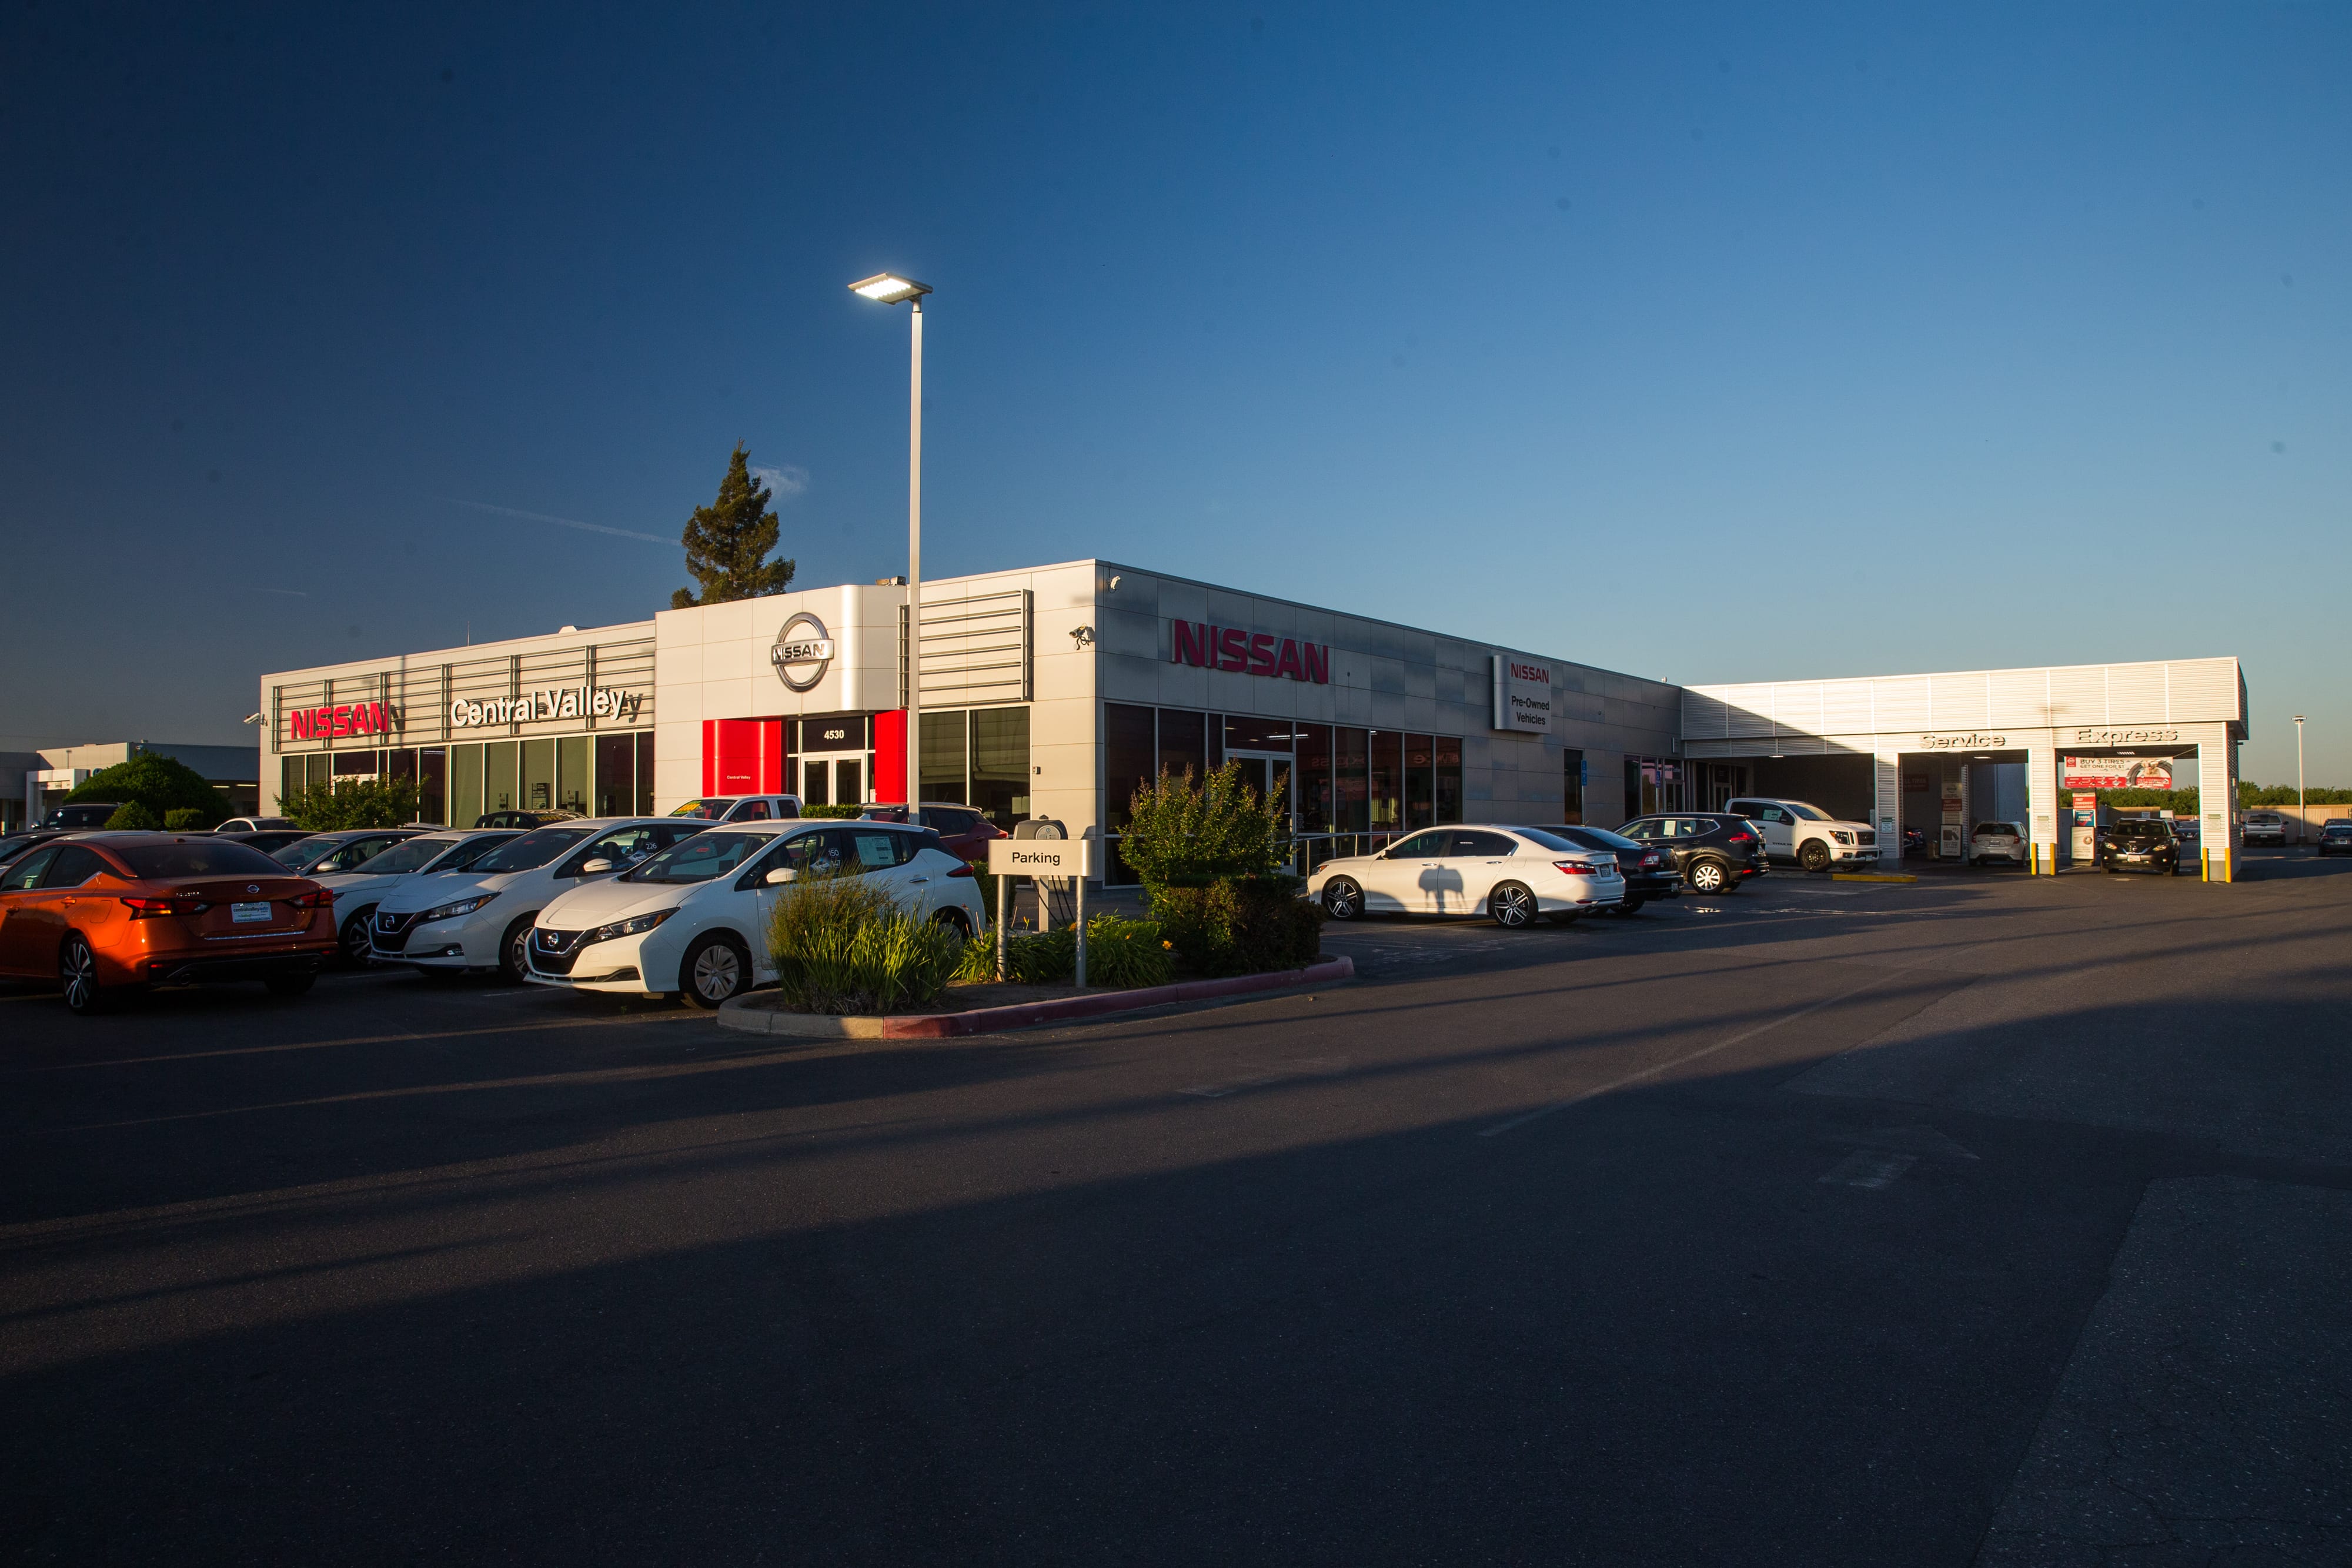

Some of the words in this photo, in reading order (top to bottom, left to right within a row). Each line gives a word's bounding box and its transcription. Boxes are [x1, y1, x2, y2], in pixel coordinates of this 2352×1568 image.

[773, 643, 825, 661] NISSAN
[1175, 619, 1328, 684] NISSAN
[1511, 663, 1549, 684] NISSAN
[450, 691, 537, 727] Central
[545, 686, 626, 721] Valley
[1511, 696, 1550, 710] Pre-Owned
[291, 701, 388, 740] NISSAN
[1516, 711, 1546, 725] Vehicles
[824, 730, 844, 740] 4530
[1919, 733, 2006, 749] Service
[2075, 728, 2178, 747] Express
[1012, 852, 1060, 866] Parking
